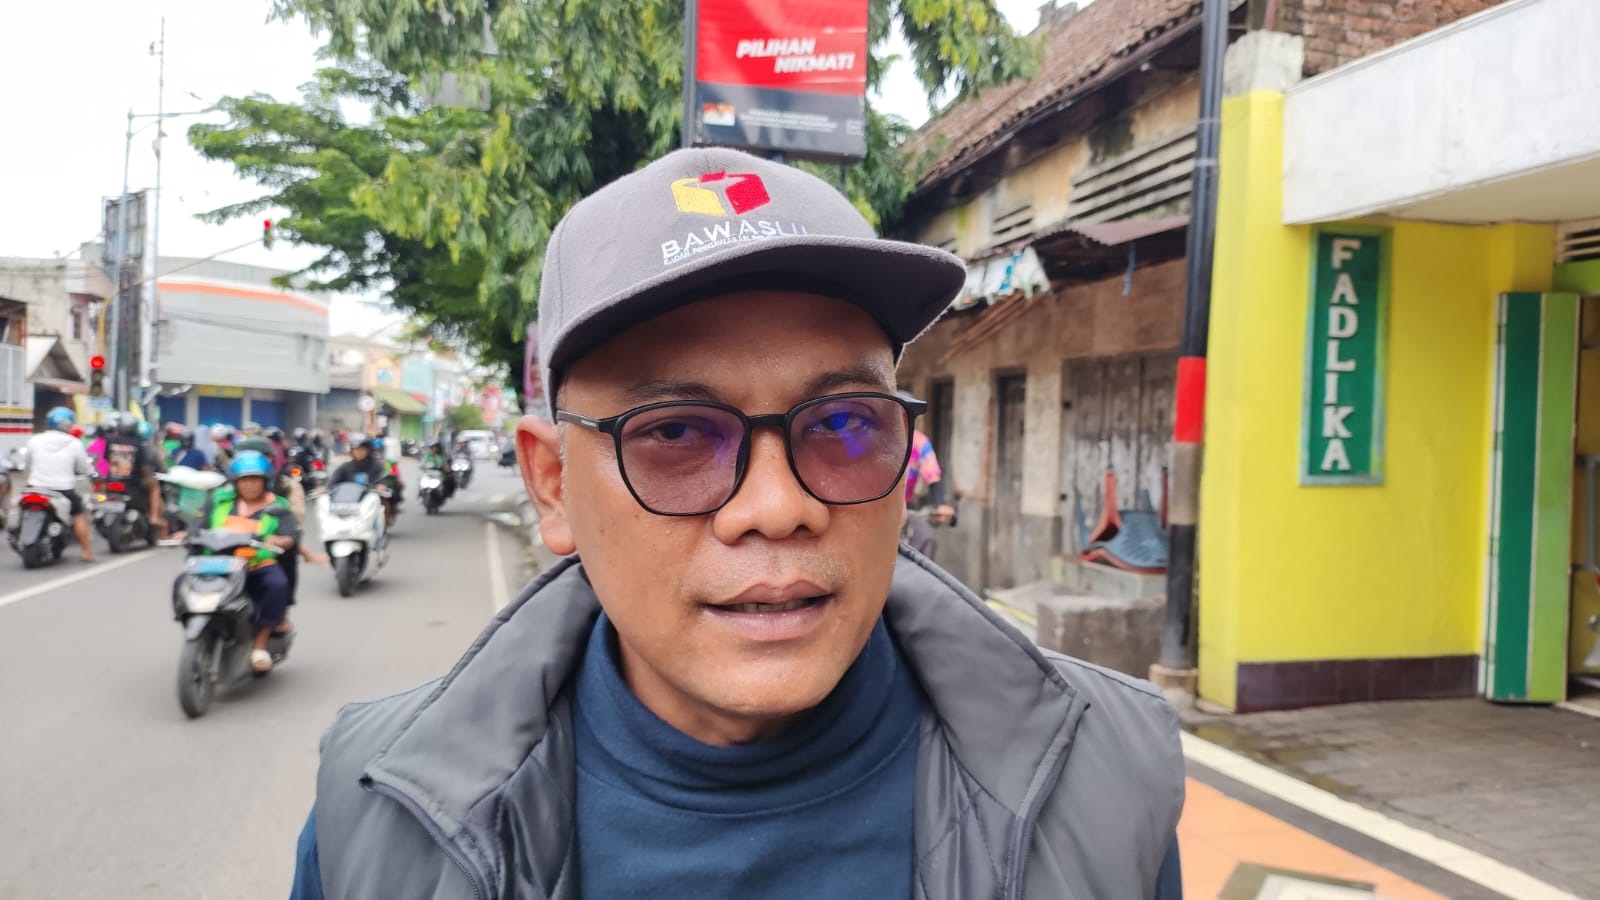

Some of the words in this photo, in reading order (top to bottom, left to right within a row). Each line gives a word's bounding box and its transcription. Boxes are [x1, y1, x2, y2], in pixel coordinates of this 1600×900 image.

[736, 37, 816, 59] PILIHAN
[660, 219, 808, 260] BAWASLU
[1320, 237, 1362, 471] FADLIKA
